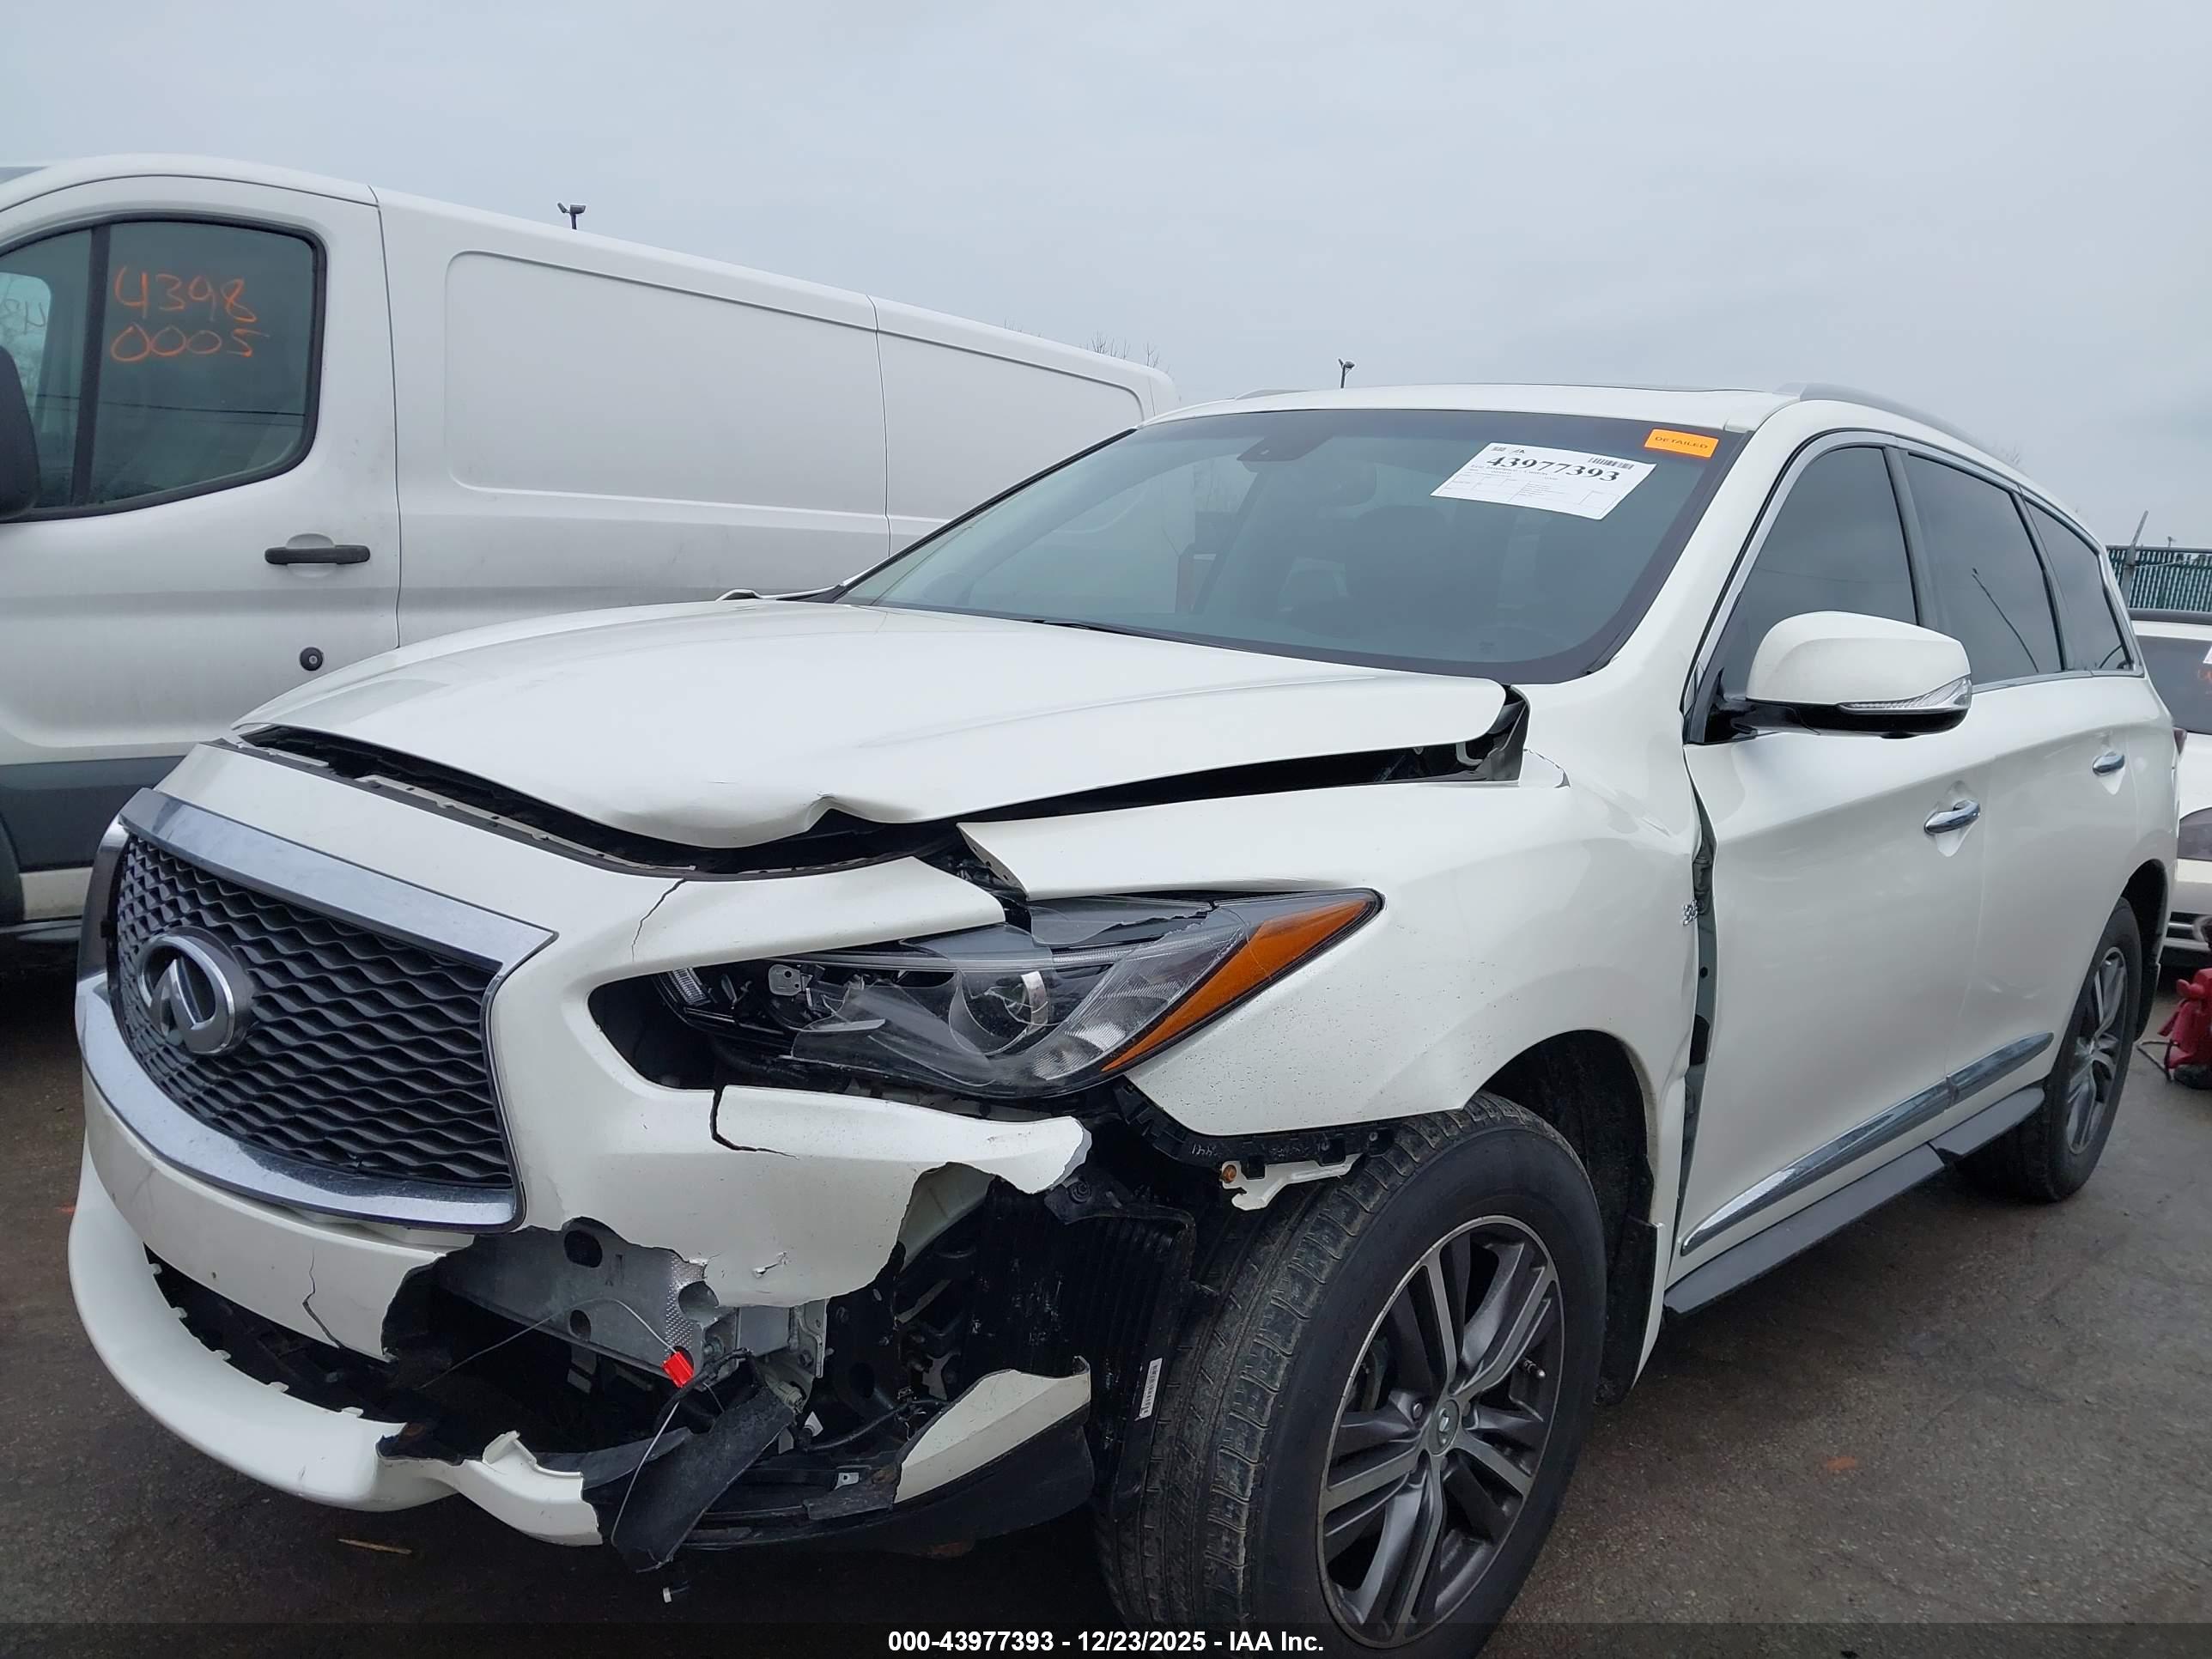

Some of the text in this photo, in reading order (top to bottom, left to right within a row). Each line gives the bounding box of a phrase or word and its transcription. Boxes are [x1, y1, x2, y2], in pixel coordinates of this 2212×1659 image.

[113, 265, 257, 323] 4398
[111, 321, 270, 362] 0005
[1654, 434, 1709, 449] DETAILED
[1486, 456, 1620, 482] 43977393
